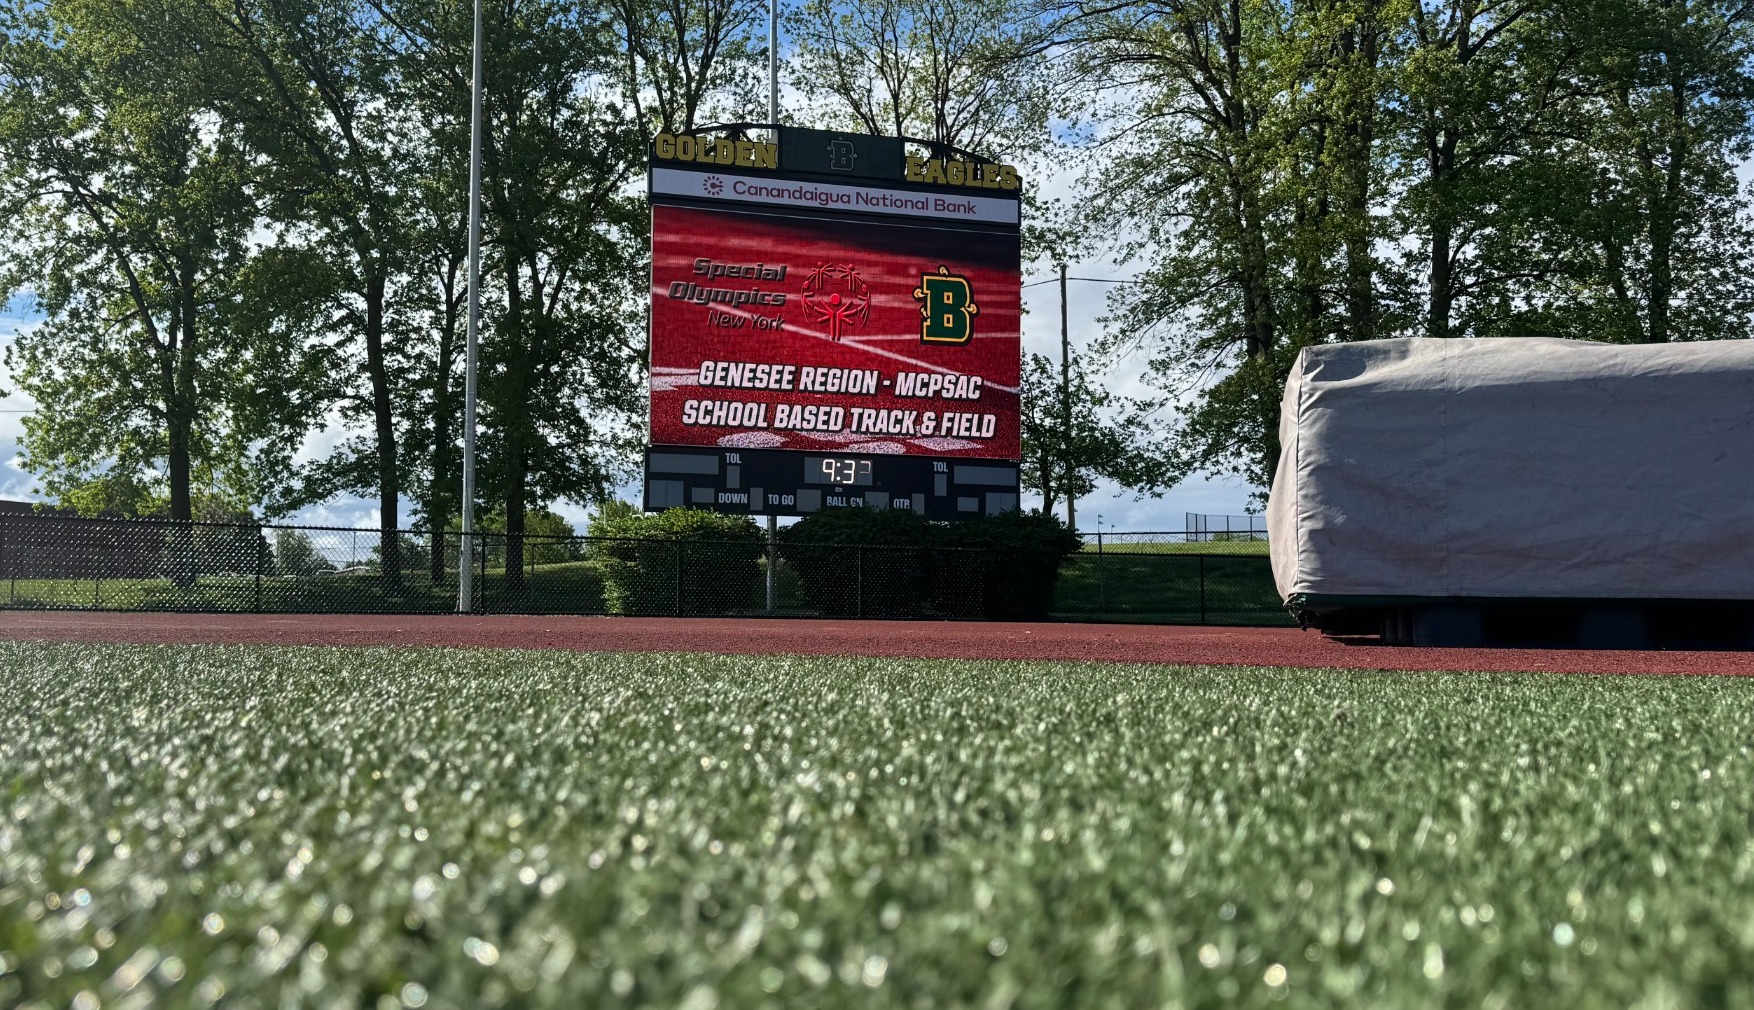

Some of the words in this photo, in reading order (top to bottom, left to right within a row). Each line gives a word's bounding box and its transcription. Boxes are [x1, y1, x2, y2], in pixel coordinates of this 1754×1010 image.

[655, 133, 778, 169] GOLDEN
[827, 138, 856, 171] B
[905, 156, 1018, 190] EAGLES
[732, 180, 851, 206] Canandaigua
[855, 191, 928, 211] National
[934, 199, 977, 215] Bank
[693, 257, 787, 282] Special
[668, 281, 787, 307] Olympics
[707, 310, 746, 328] New
[751, 313, 785, 331] York
[921, 275, 971, 345] B
[698, 360, 795, 390] GENESEE
[799, 366, 878, 394] REGION
[894, 372, 982, 400] MCPSAC
[682, 399, 769, 428] SCHOOL
[773, 405, 845, 431] BASED
[849, 408, 916, 434] TRACK
[920, 414, 937, 435] &
[940, 413, 996, 438] FIELD
[725, 453, 742, 464] TOL
[933, 461, 949, 472] TOL
[718, 492, 748, 504] DOWN
[768, 494, 779, 505] TO
[781, 495, 794, 506] GO
[826, 496, 848, 507] BALL
